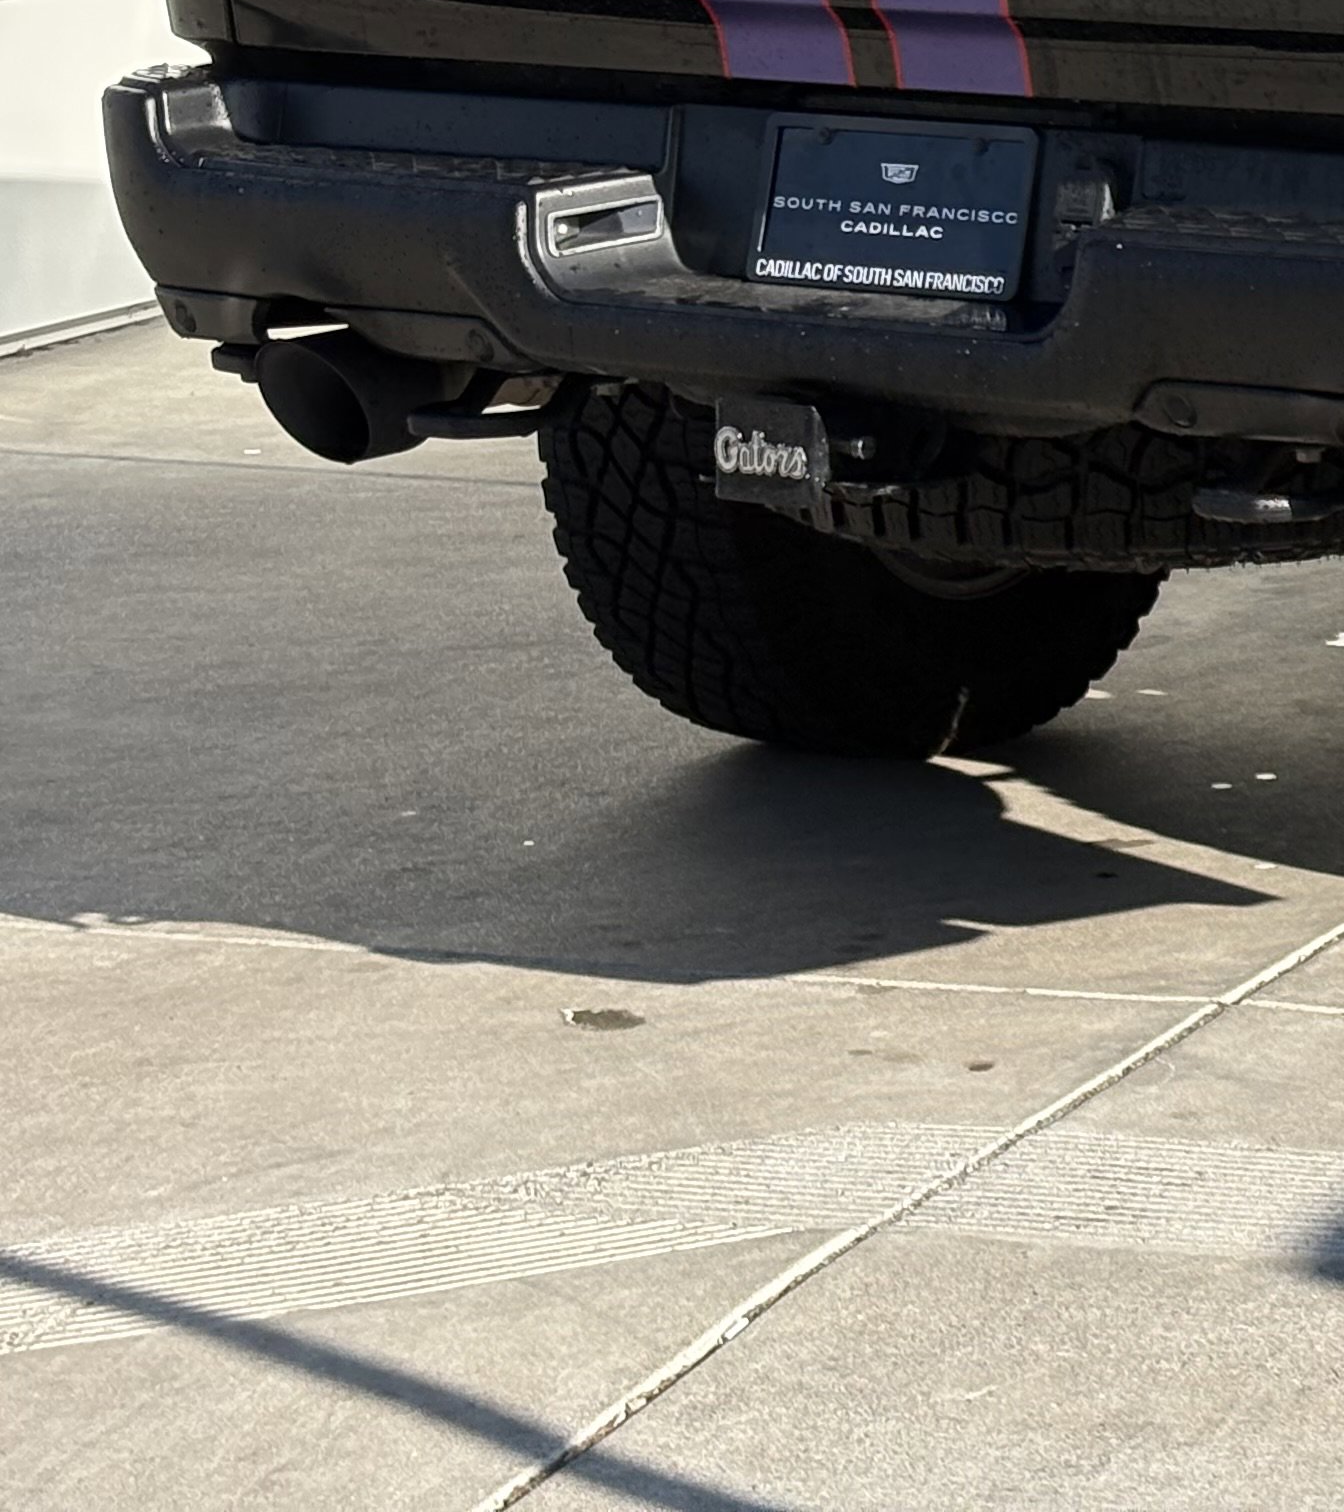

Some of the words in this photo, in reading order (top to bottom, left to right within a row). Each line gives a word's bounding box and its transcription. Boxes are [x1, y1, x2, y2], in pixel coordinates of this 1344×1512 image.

[773, 195, 842, 213] SOUTH
[849, 199, 892, 216] SAN
[899, 204, 1019, 225] FRANCISCO
[840, 219, 944, 240] CADILLAC
[755, 258, 823, 281] CADILLAC
[823, 263, 842, 282] OF
[844, 265, 892, 287] SOUTH
[893, 269, 925, 289] SAN
[925, 271, 1005, 295] FRANCISCO
